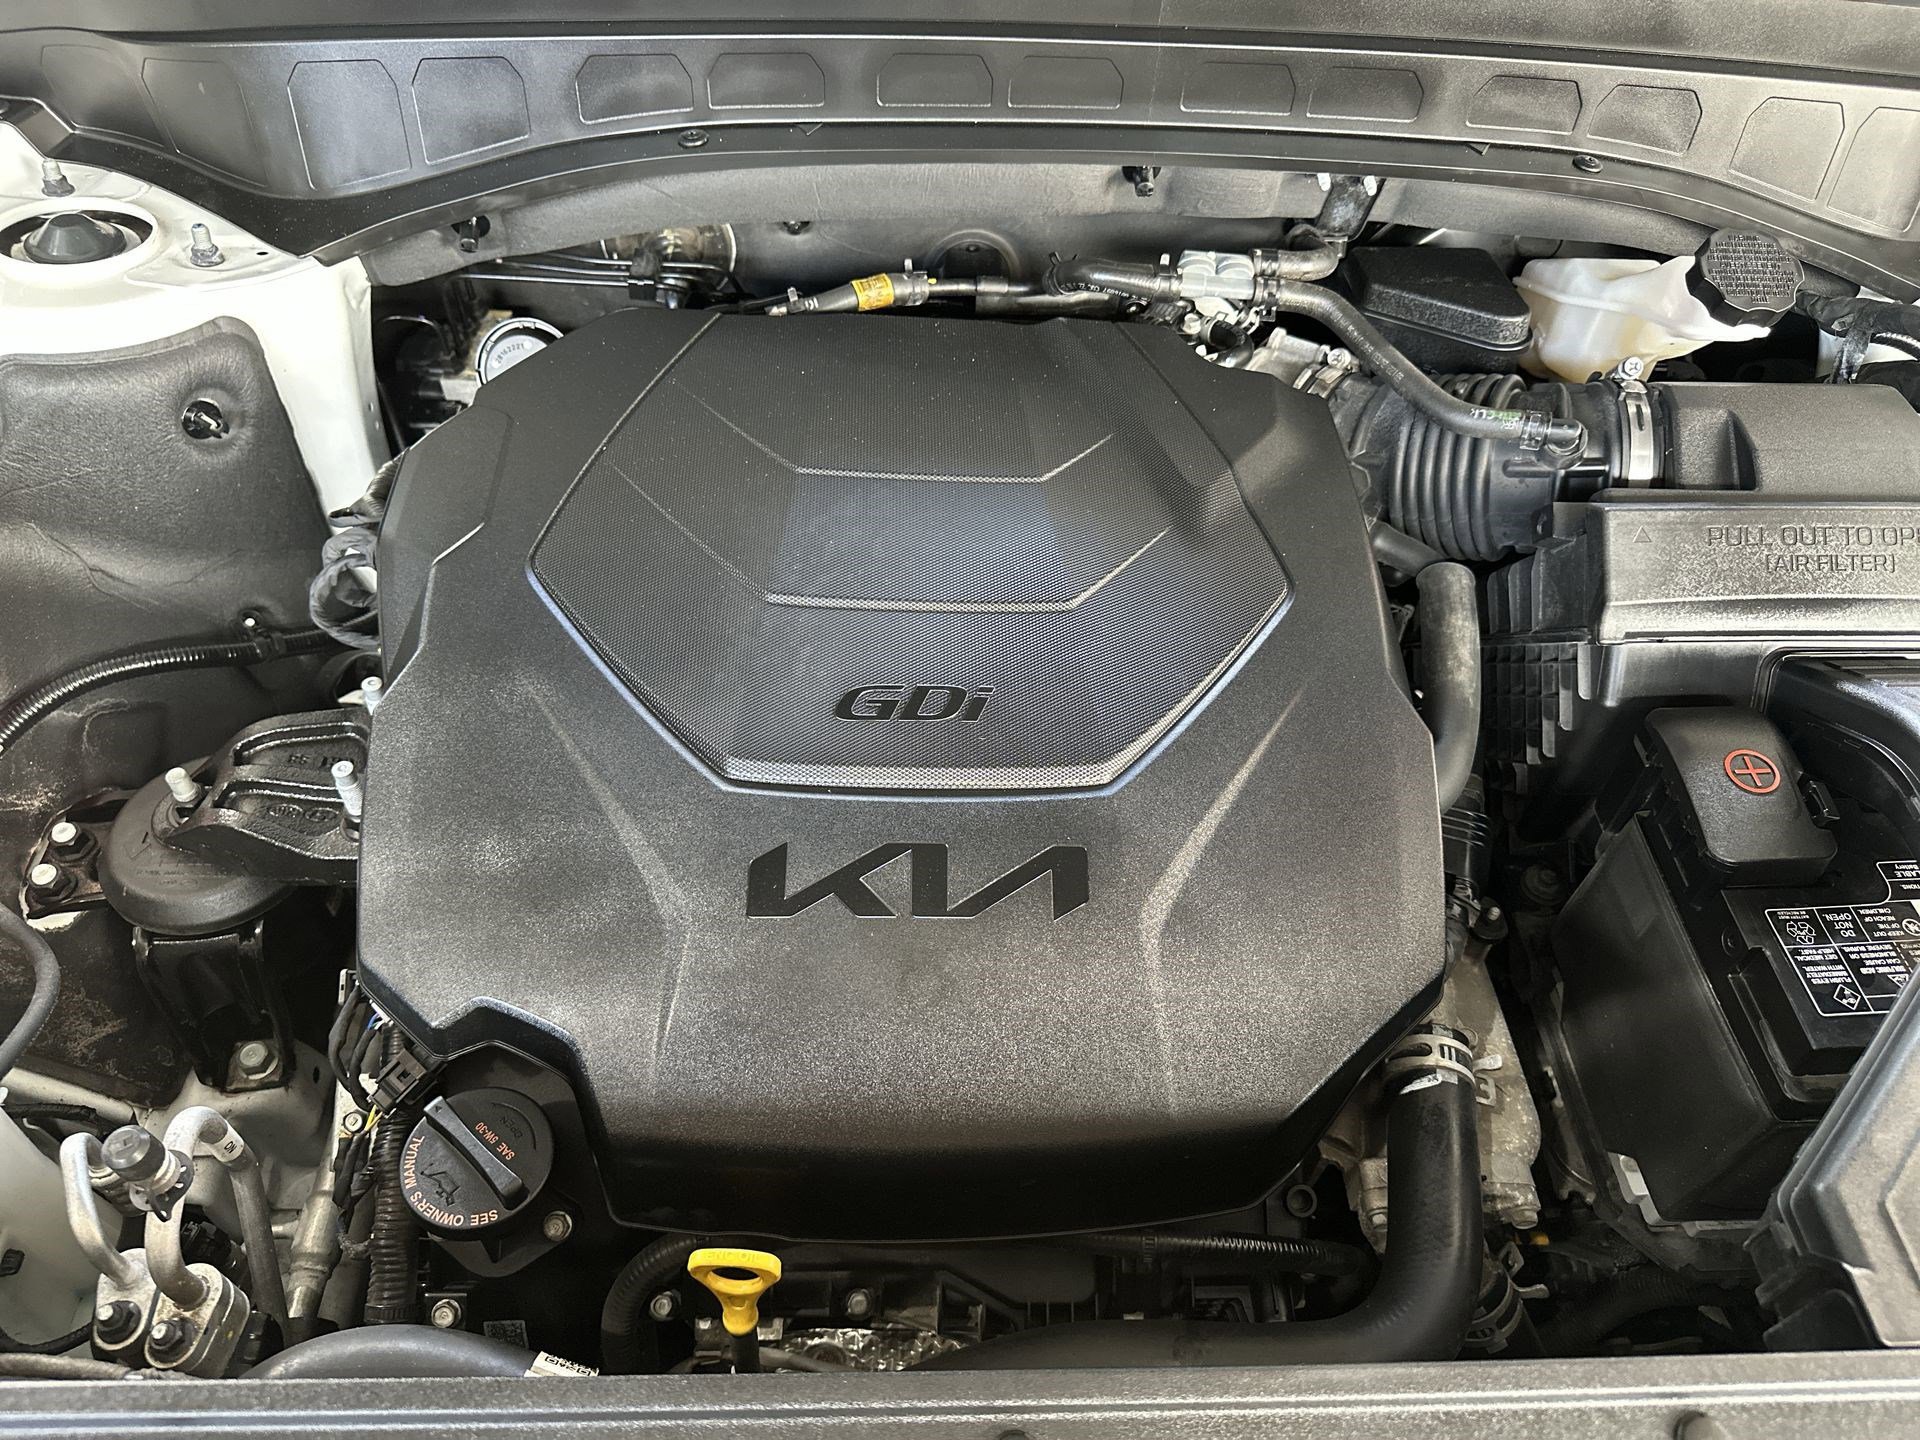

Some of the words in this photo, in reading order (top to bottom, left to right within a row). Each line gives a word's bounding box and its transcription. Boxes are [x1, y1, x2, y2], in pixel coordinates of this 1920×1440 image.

[1706, 525, 1772, 547] PULL
[1781, 525, 1832, 546] OUT
[1835, 525, 1873, 546] TO
[834, 684, 995, 723] GDi
[747, 842, 1089, 922] KIA
[1822, 912, 1852, 921] OPEN.
[1806, 970, 1848, 978] IMMEDIATELY
[1876, 965, 1906, 973] SULFURIC
[475, 1122, 499, 1143] 5W-30
[500, 1116, 523, 1138] OPEN
[496, 1142, 515, 1160] SAE
[404, 1136, 424, 1189] MANUAL
[410, 1191, 464, 1226] OWNER'S
[470, 1209, 498, 1226] SEE
